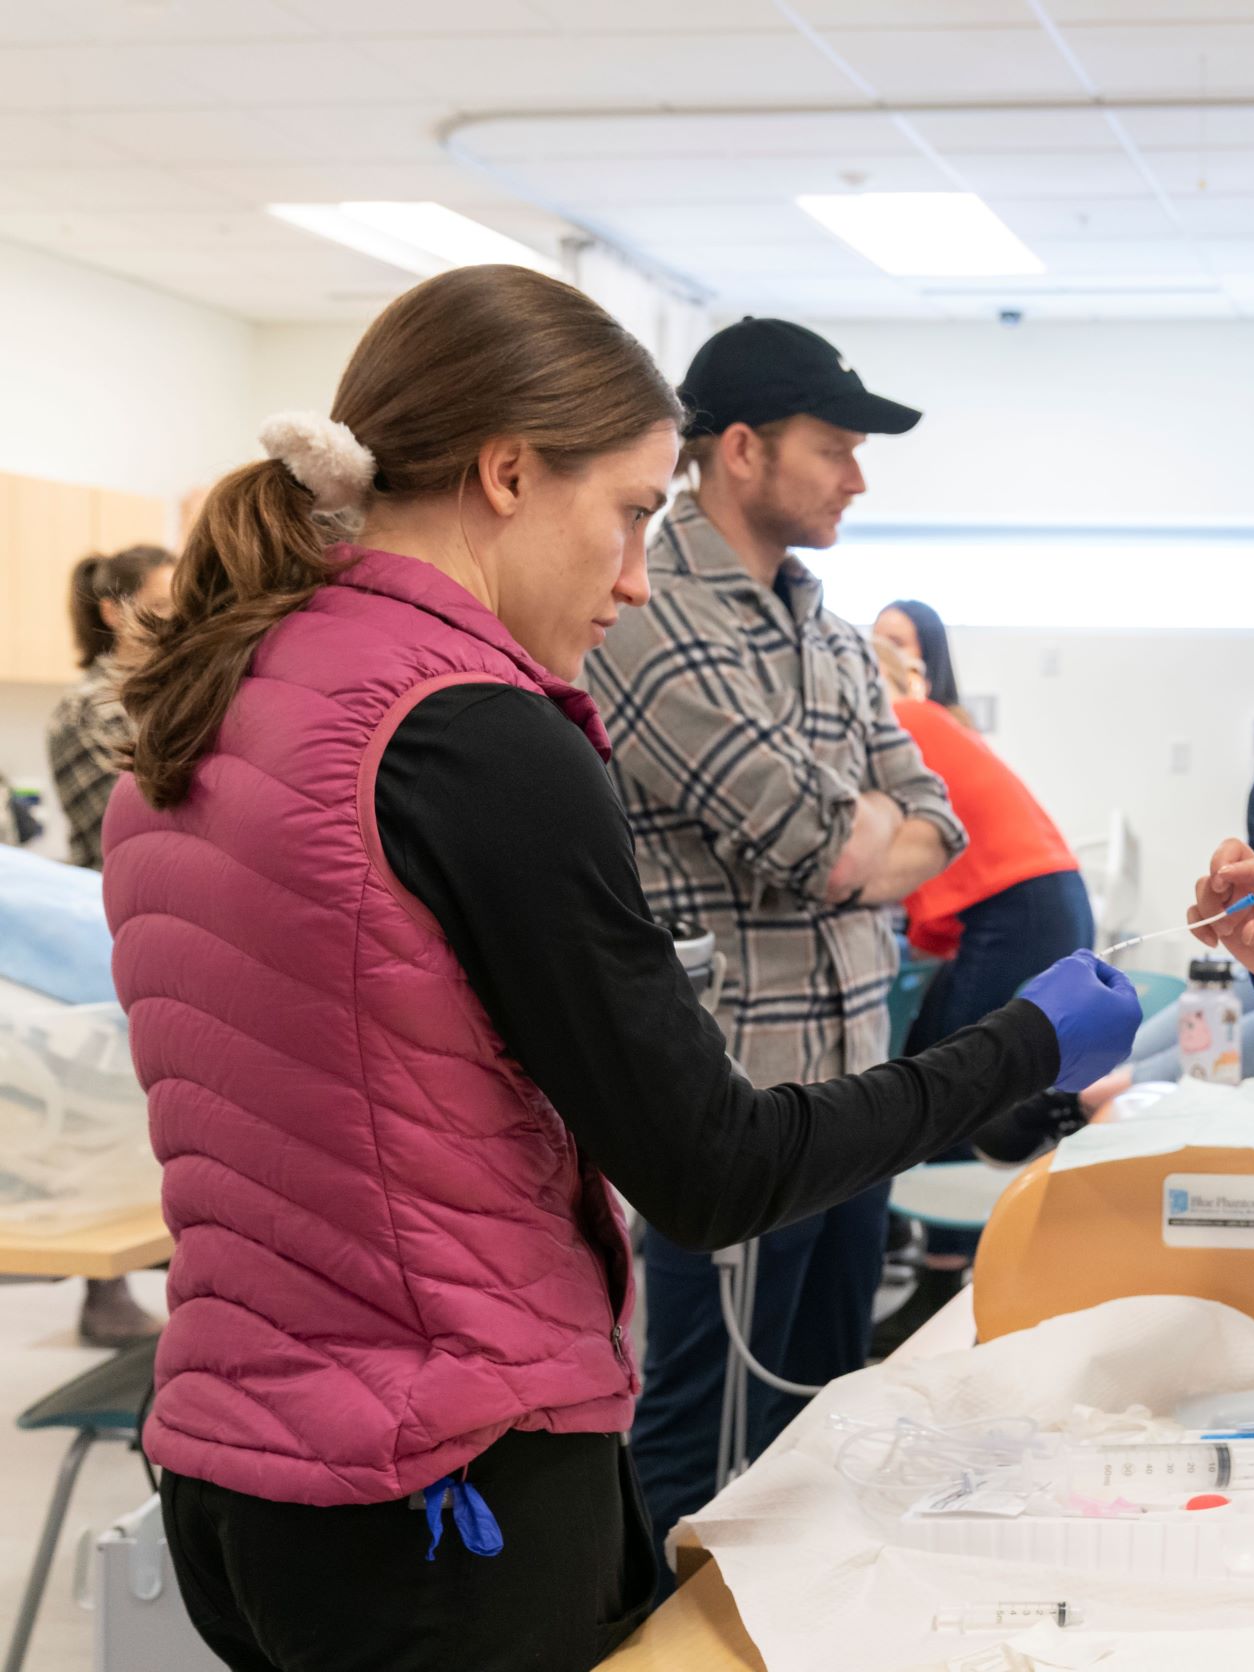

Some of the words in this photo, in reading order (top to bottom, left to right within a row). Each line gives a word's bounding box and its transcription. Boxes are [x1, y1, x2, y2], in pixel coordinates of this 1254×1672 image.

[1145, 1464, 1153, 1475] 40
[1187, 1462, 1195, 1474] 20
[1208, 1462, 1216, 1473] 10
